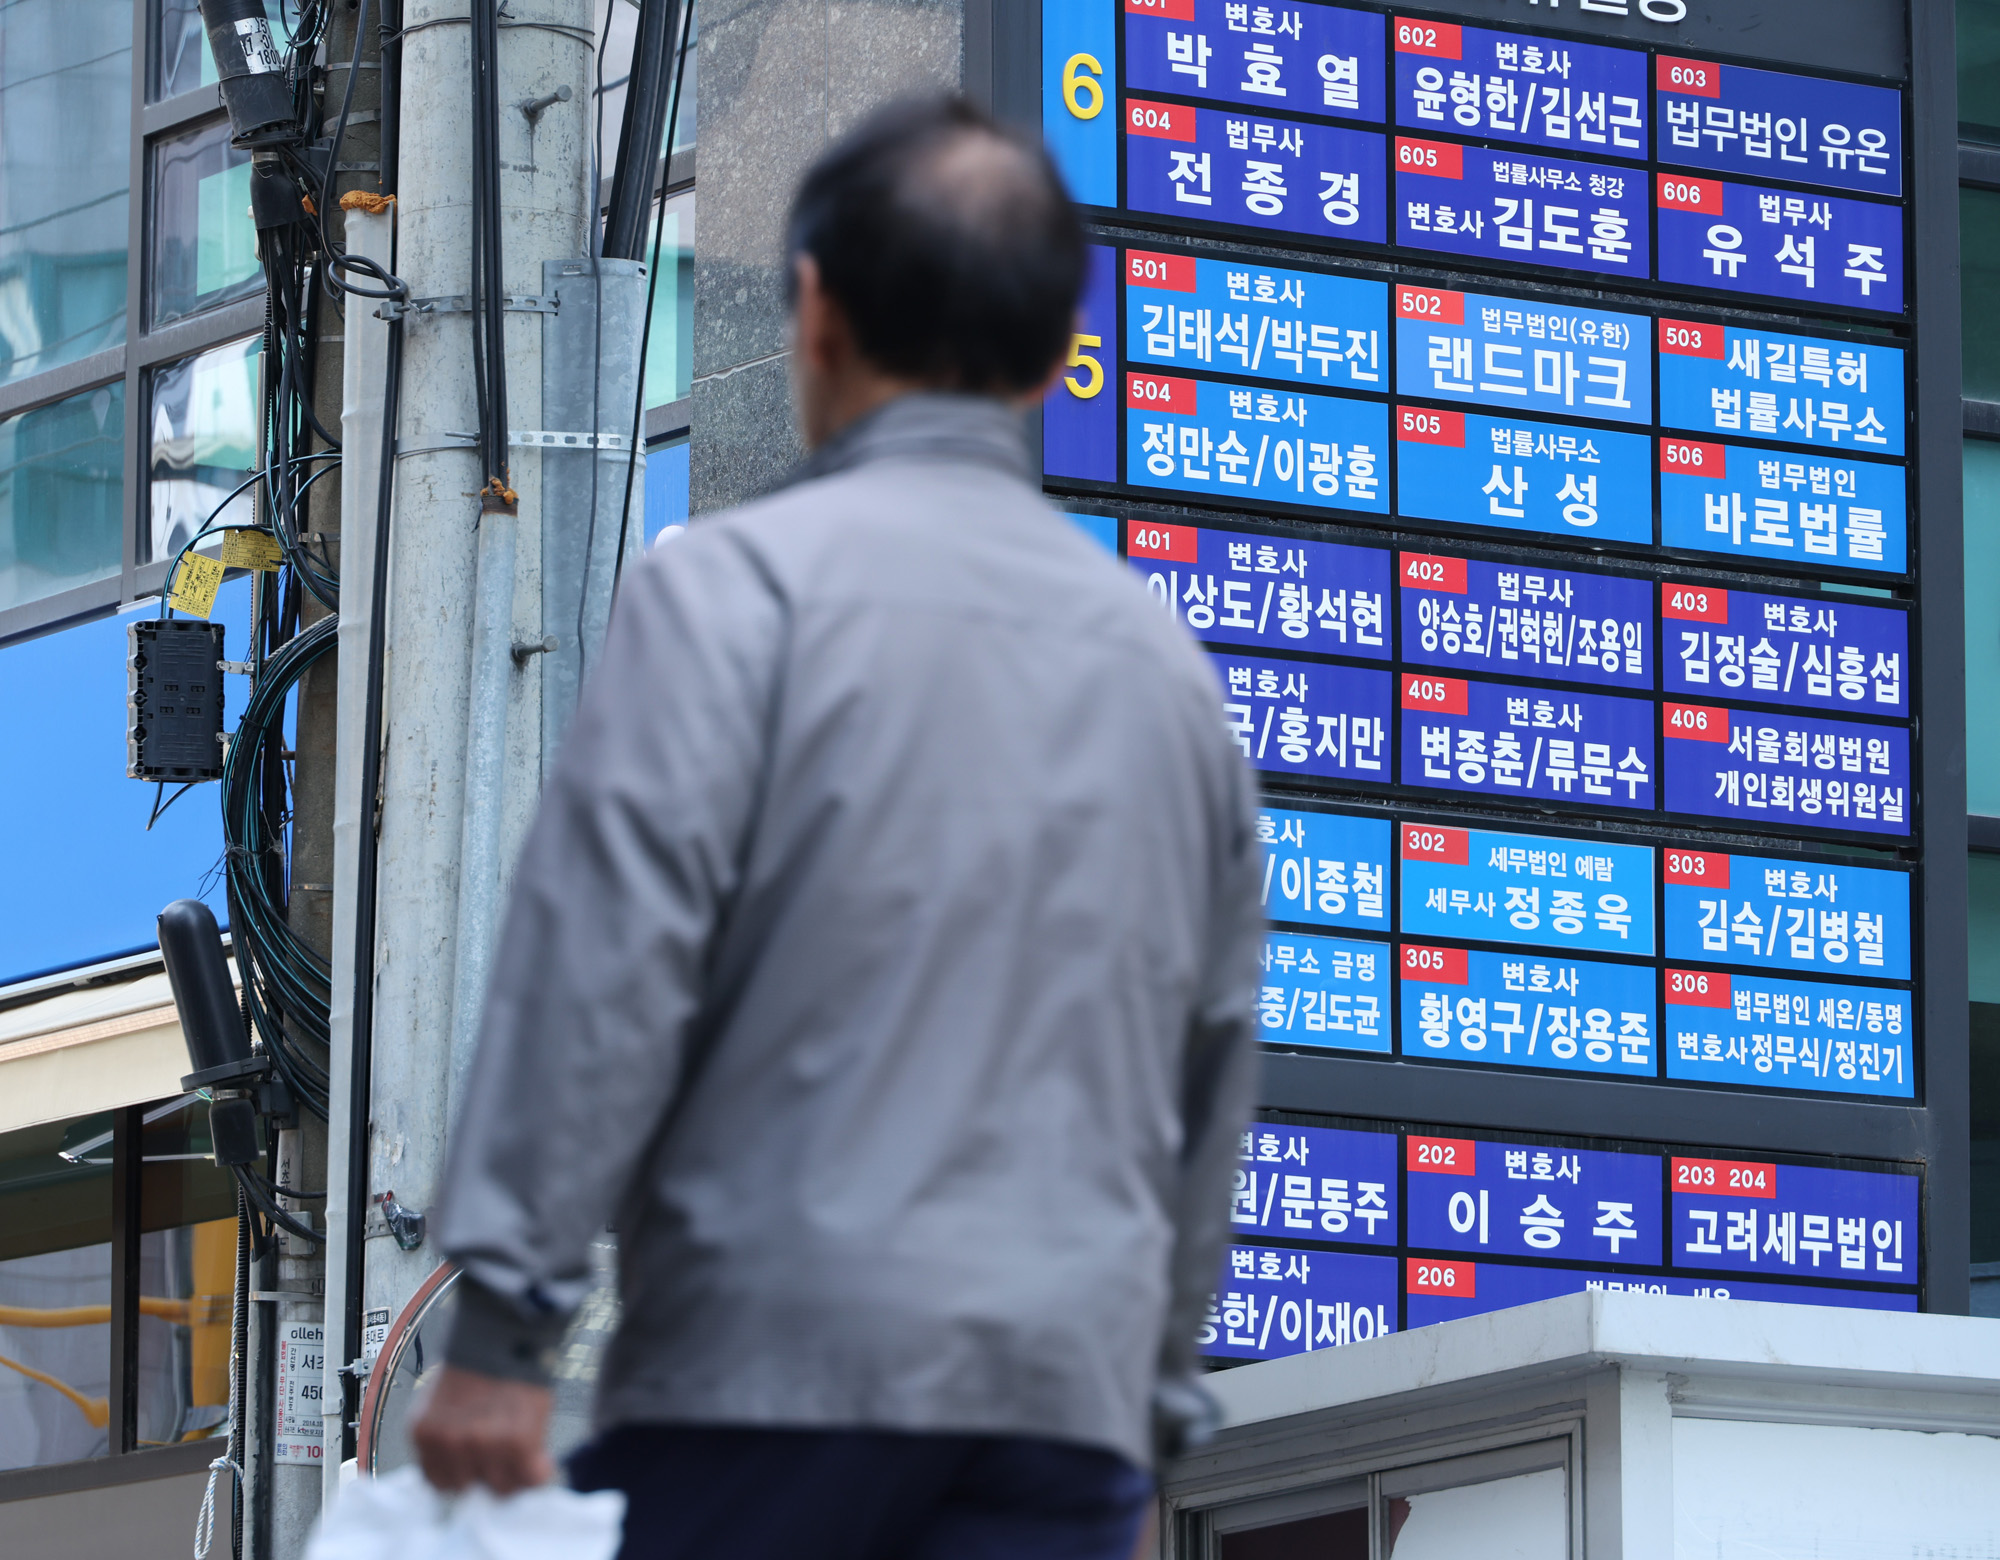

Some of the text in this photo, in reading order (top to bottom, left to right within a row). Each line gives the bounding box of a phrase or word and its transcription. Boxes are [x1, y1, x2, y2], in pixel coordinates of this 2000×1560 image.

[1225, 2, 1303, 41] 변호사
[1398, 25, 1437, 48] 602
[1492, 41, 1572, 83] 변호사
[1670, 66, 1707, 88] 603
[1062, 53, 1104, 120] 6
[1131, 107, 1171, 131] 604
[1413, 63, 1642, 152] 윤형한/김선근
[1226, 119, 1304, 158] 법무사
[1667, 100, 1890, 175] 법무법인 유온
[1399, 145, 1438, 168] 605
[1492, 160, 1625, 199] 법률사무소 청강
[1663, 181, 1701, 204] 606
[1407, 194, 1632, 264] 변호사 김도훈
[1759, 194, 1833, 231] 법무사
[1131, 258, 1167, 281] 501
[1227, 271, 1305, 309] 변호사
[1402, 292, 1441, 316] 502
[1138, 300, 1379, 385] 김태석/박두진
[1481, 307, 1630, 354] 법무법인(유한)
[1666, 327, 1702, 349] 503
[1064, 332, 1105, 399] 5
[1428, 332, 1632, 409] 랜드마크
[1724, 338, 1867, 397] 새길특허
[1132, 379, 1171, 402] 504
[1229, 390, 1308, 428] 변호사
[1403, 412, 1441, 435] 505
[1711, 384, 1887, 445] 법률사무소
[1141, 419, 1379, 500] 정만순/이광훈
[1491, 427, 1601, 464] 법률사무소
[1666, 444, 1703, 466] 506
[1755, 460, 1856, 501] 법무법인
[1135, 528, 1170, 551] 401
[1704, 489, 1887, 561] 바로법률
[1228, 542, 1308, 579] 변호사
[1406, 560, 1444, 582] 402
[1143, 567, 1383, 649] 이상도/황석현
[1497, 571, 1574, 611] 법무사
[1671, 591, 1708, 613] 403
[1418, 594, 1643, 675] 양승호/권혁헌/조용일
[1760, 602, 1838, 641] 변호사
[1679, 627, 1900, 705] 김정술/심흥섭
[1225, 666, 1309, 706] 변호사
[1408, 679, 1446, 702] 405
[1503, 697, 1583, 735] 변호사
[1670, 708, 1708, 730] 406
[1420, 722, 1649, 800] 변종춘/류문수
[1727, 725, 1890, 778] 서울회생법원
[1714, 767, 1903, 823] 개인회생위원실
[1408, 830, 1445, 853] 302
[1487, 846, 1614, 883] 세무법인 예람
[1668, 854, 1706, 876] 303
[1425, 887, 1497, 918] 세무사
[1764, 868, 1839, 903] 변호사
[1697, 896, 1884, 967] 김숙/김병철
[1332, 950, 1376, 982] 금명
[1406, 948, 1444, 970] 305
[1502, 962, 1580, 997] 변호사
[1671, 972, 1709, 994] 306
[1251, 986, 1381, 1036] 중/김도균
[1418, 989, 1651, 1065] 황영구/장용준
[1734, 990, 1902, 1035] 법무법인 세온/동명
[1418, 1144, 1456, 1165] 202
[1505, 1150, 1582, 1185] 변호사
[1678, 1164, 1766, 1190] 203 204
[1685, 1208, 1903, 1272] 고려세무법인
[1231, 1249, 1311, 1285] 변호사
[1417, 1266, 1456, 1287] 206
[290, 1327, 323, 1340] olleh
